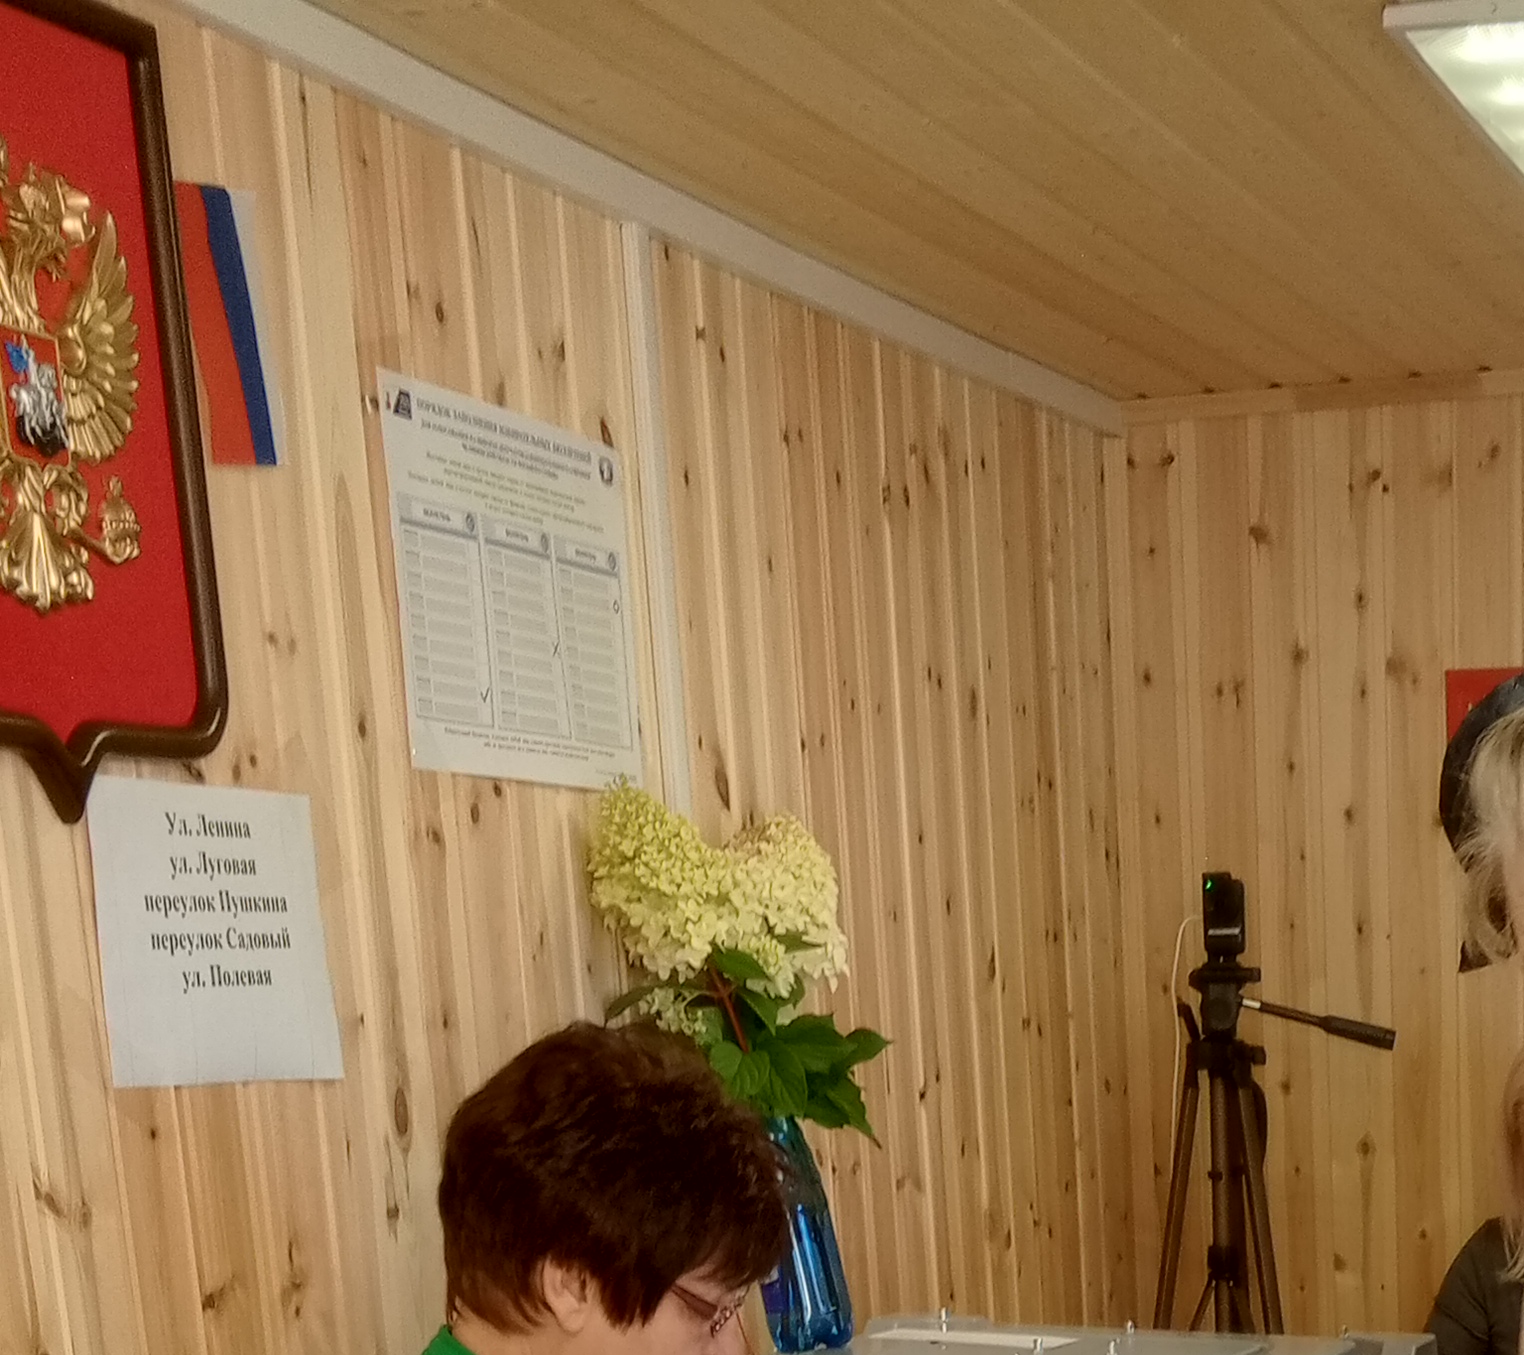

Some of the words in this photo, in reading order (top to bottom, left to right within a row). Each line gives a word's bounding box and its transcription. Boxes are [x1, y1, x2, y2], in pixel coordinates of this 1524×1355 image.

[165, 812, 192, 837] Ул.
[196, 814, 251, 839] Ленина
[170, 854, 192, 880] ул.
[196, 852, 257, 881] Луговая
[144, 894, 216, 918] переулок
[218, 889, 288, 918] Пушкина
[151, 931, 223, 956] переулок
[225, 927, 291, 952] Садовый
[182, 969, 206, 994] ул.
[209, 964, 273, 988] Полевая
